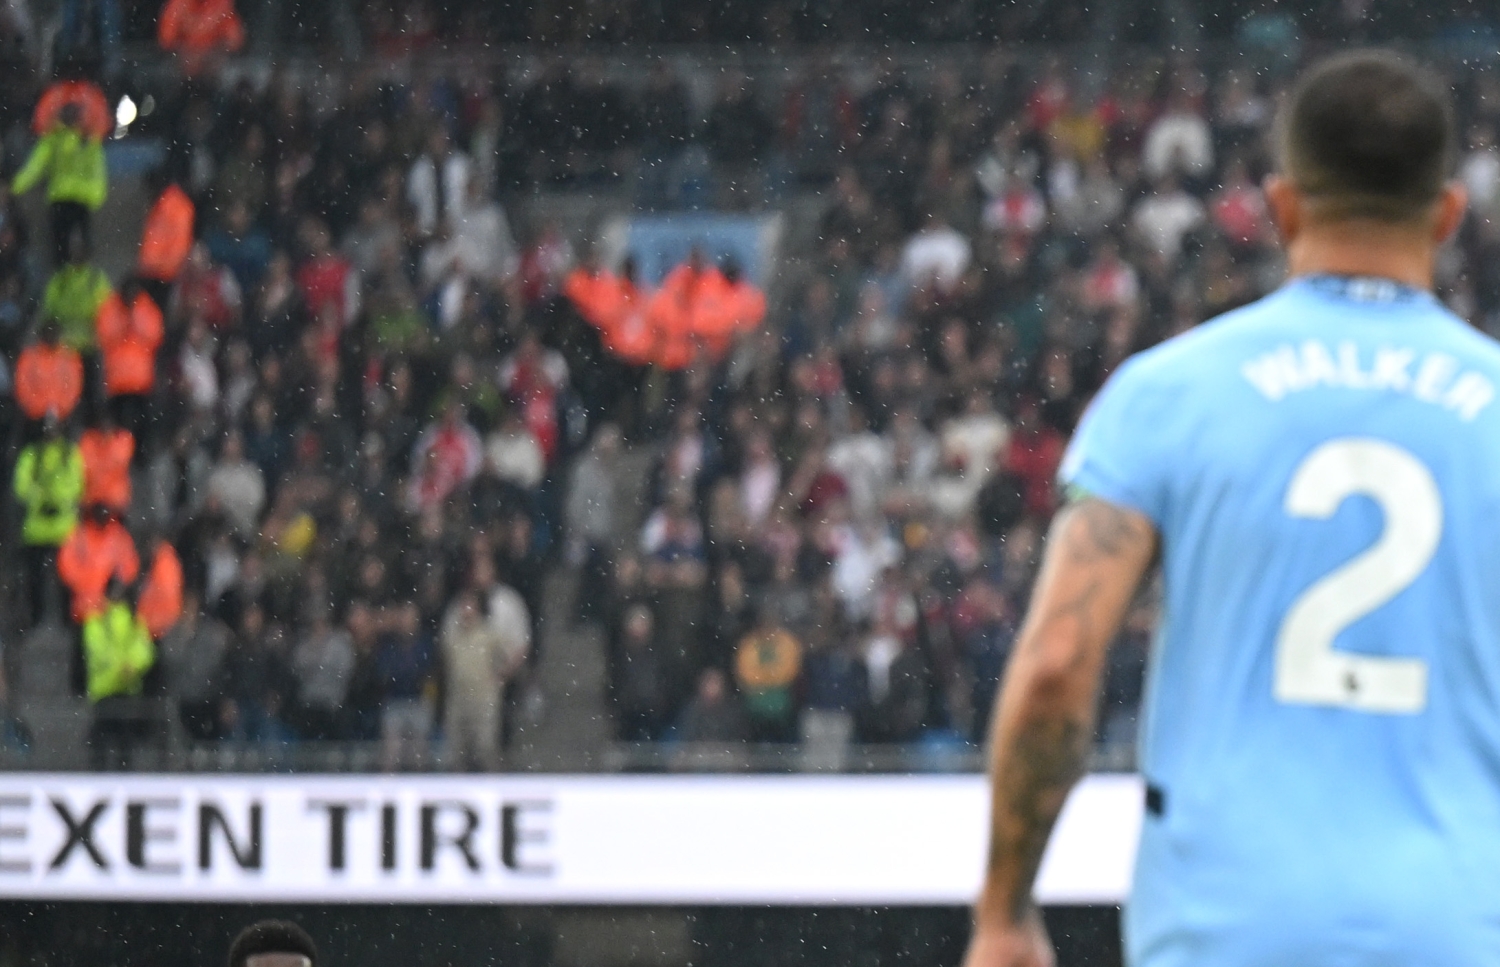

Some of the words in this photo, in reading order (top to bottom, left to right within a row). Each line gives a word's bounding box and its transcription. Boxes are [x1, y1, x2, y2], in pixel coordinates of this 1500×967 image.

[1241, 340, 1496, 421] WALKER
[1274, 436, 1444, 714] 2
[307, 799, 556, 874] TIRE
